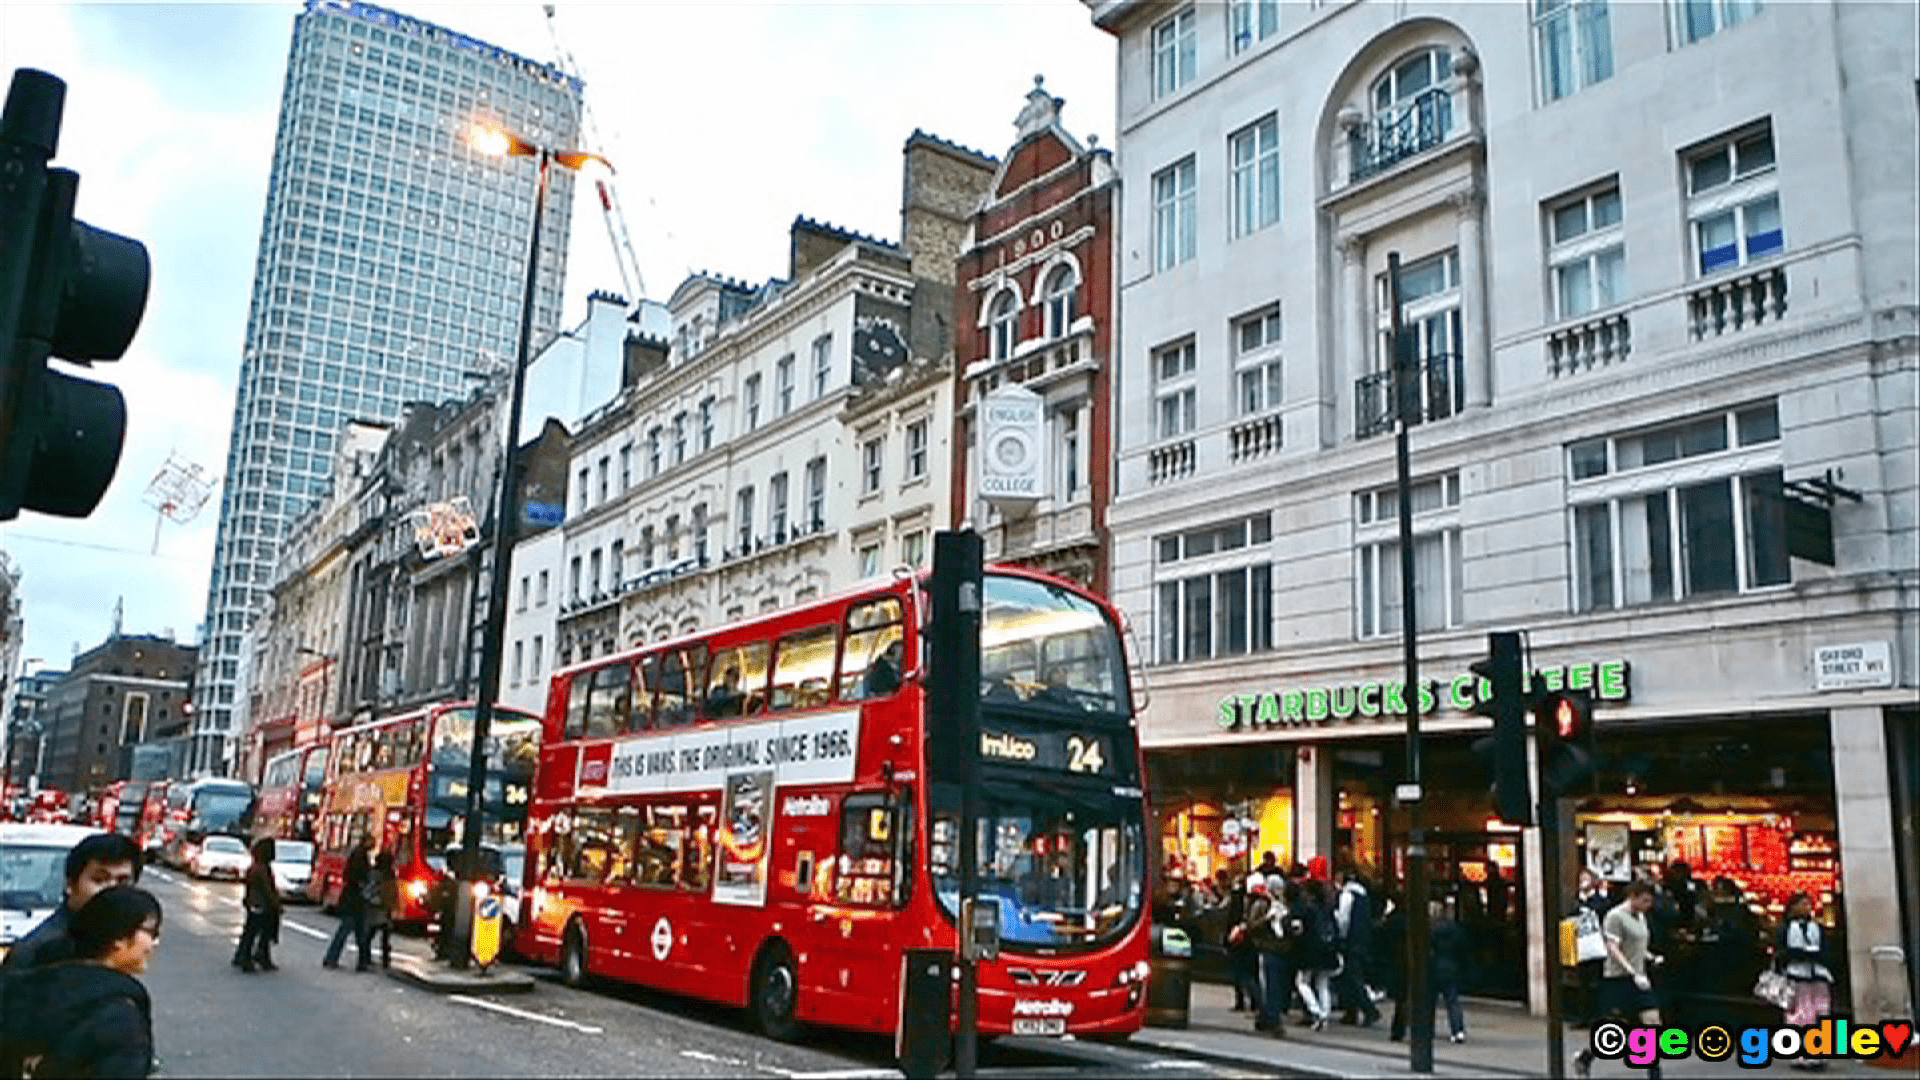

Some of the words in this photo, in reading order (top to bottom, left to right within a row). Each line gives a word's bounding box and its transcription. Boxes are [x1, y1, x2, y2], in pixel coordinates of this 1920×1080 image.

[998, 219, 1065, 266] 1900
[986, 407, 1036, 423] ENGLISH
[983, 477, 1036, 492] COLLEGE
[1218, 675, 1434, 728] STARBUCKS
[679, 748, 701, 772] THE
[703, 739, 760, 770] ORIGINAL
[766, 733, 808, 765] SINCE
[1066, 736, 1104, 774] 24
